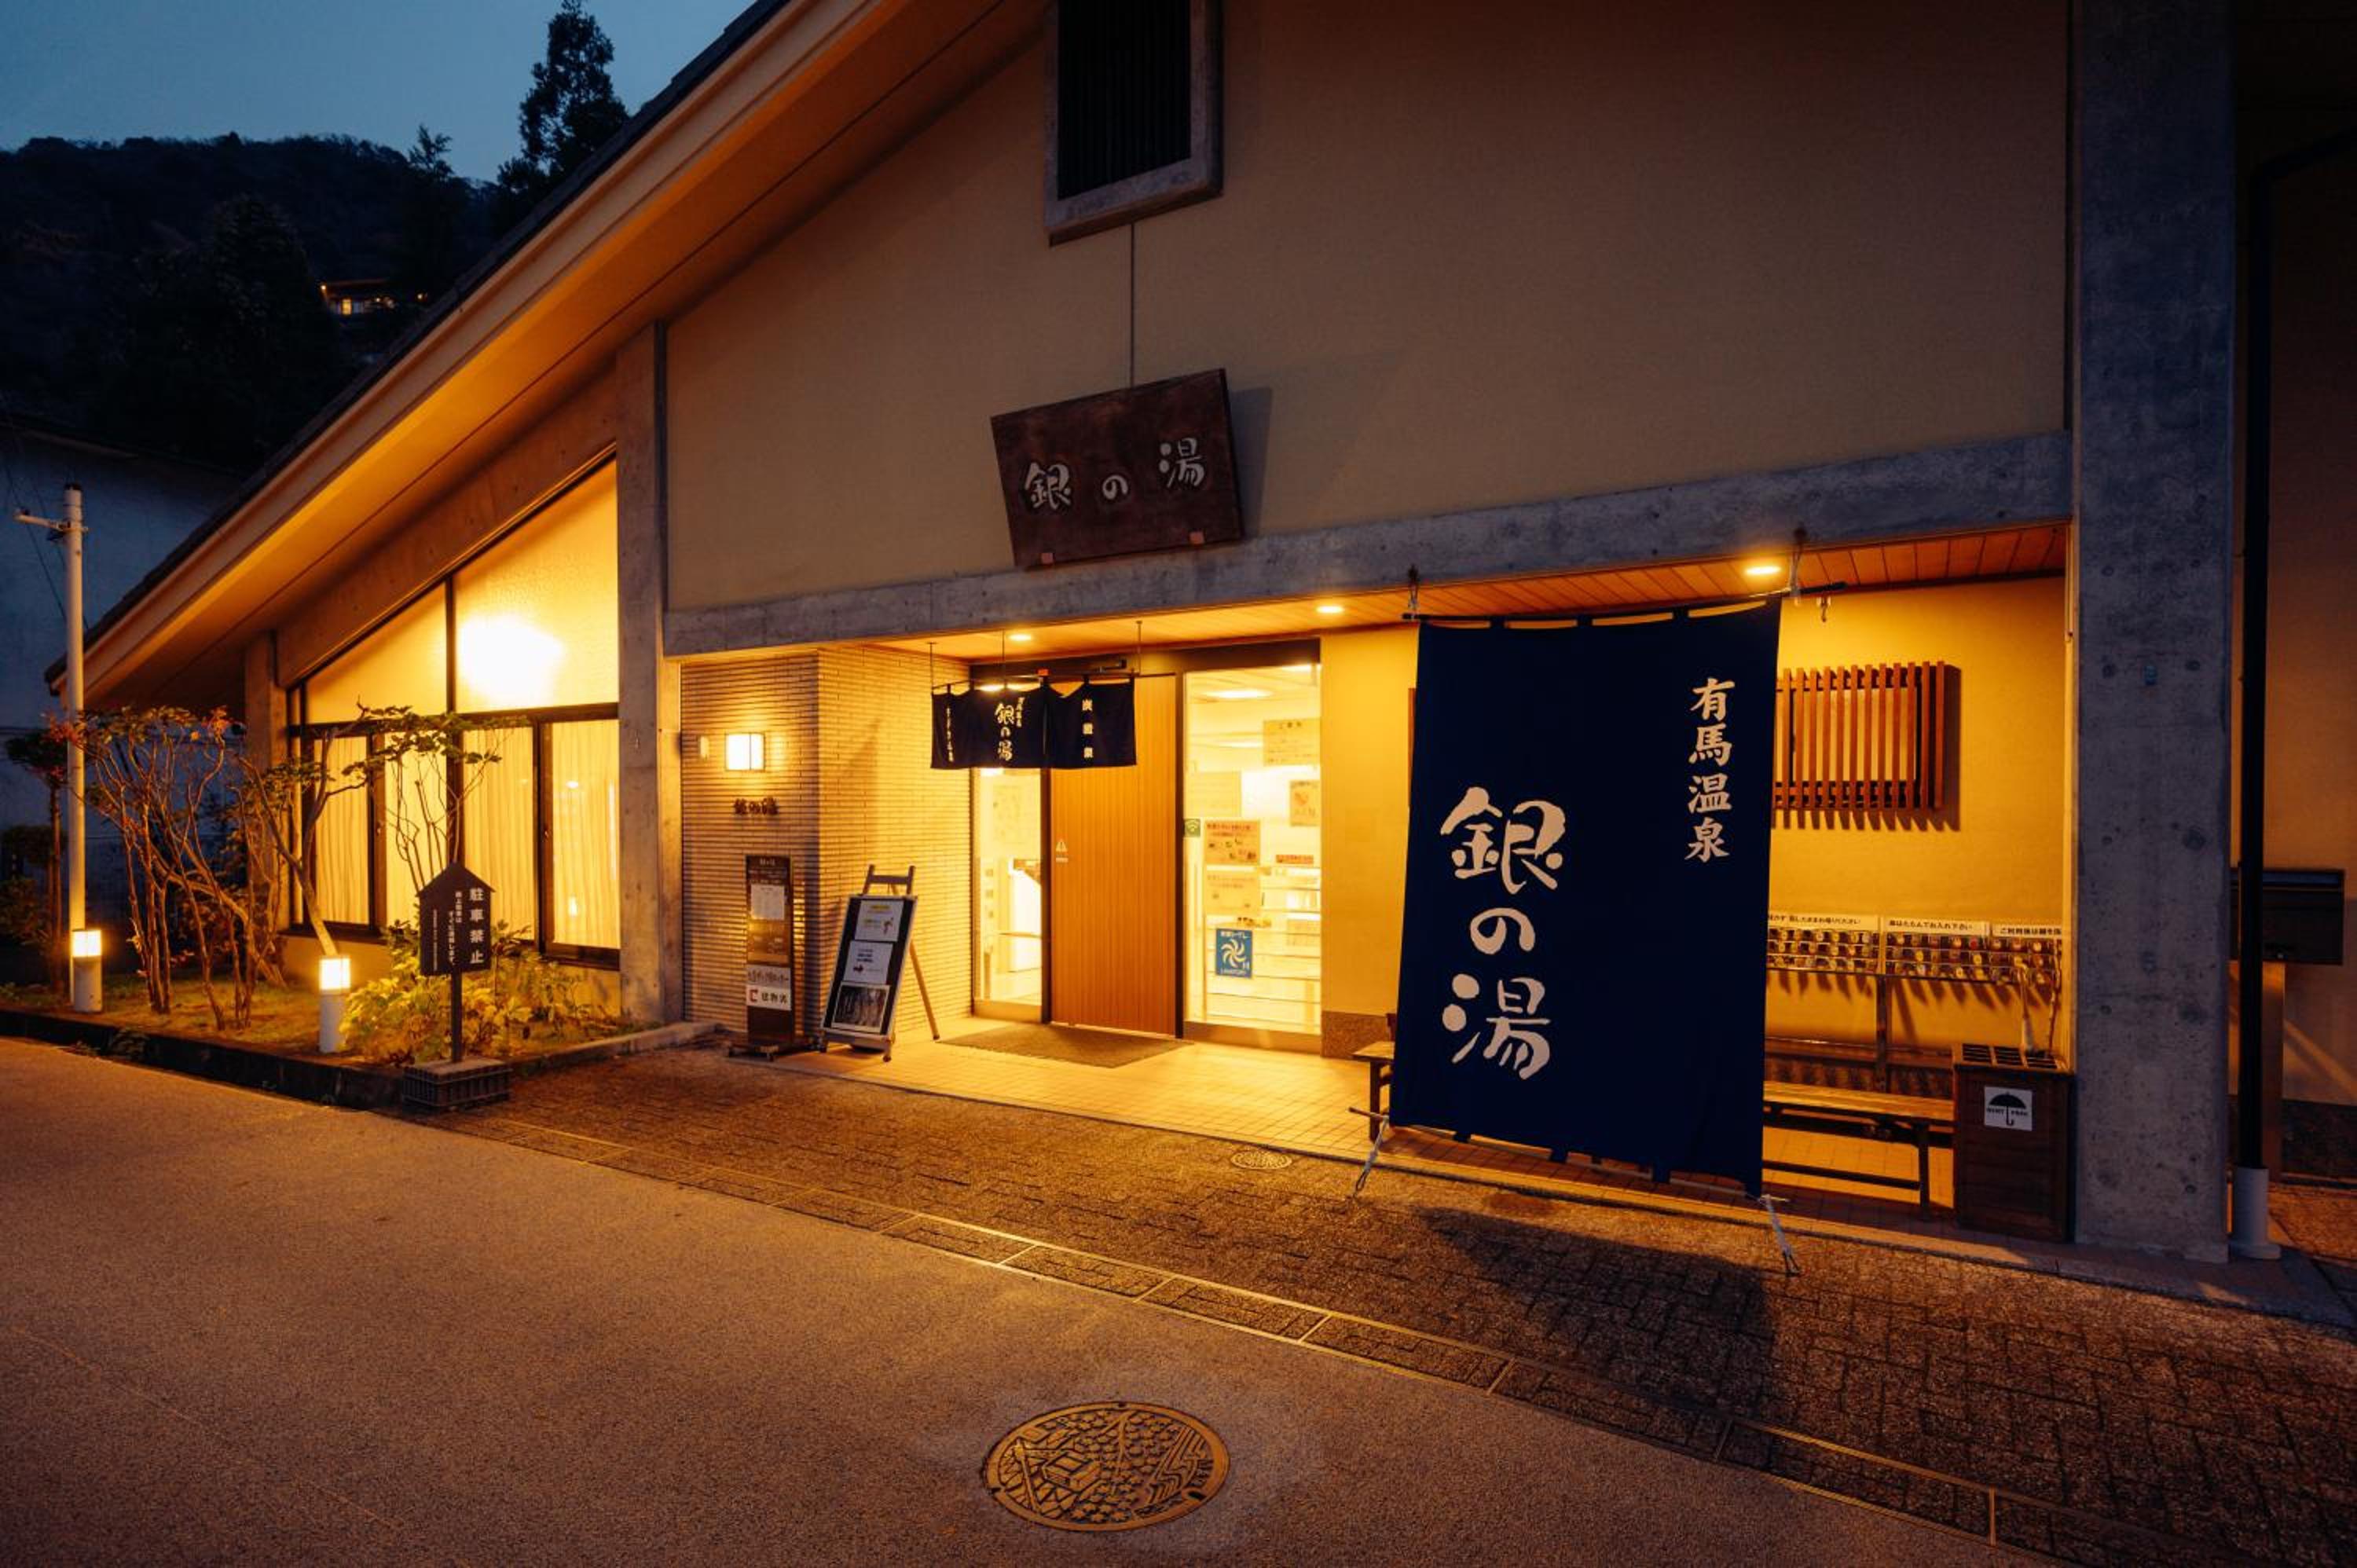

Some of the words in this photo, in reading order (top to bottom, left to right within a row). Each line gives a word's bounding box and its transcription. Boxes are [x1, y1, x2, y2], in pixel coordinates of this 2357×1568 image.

[1025, 438, 1205, 510] 銀の湯
[995, 702, 1015, 761] 銀の湯
[1684, 677, 1736, 863] 有馬温泉
[470, 887, 485, 964] 駐車禁止
[1440, 786, 1566, 1080] 銀の湯
